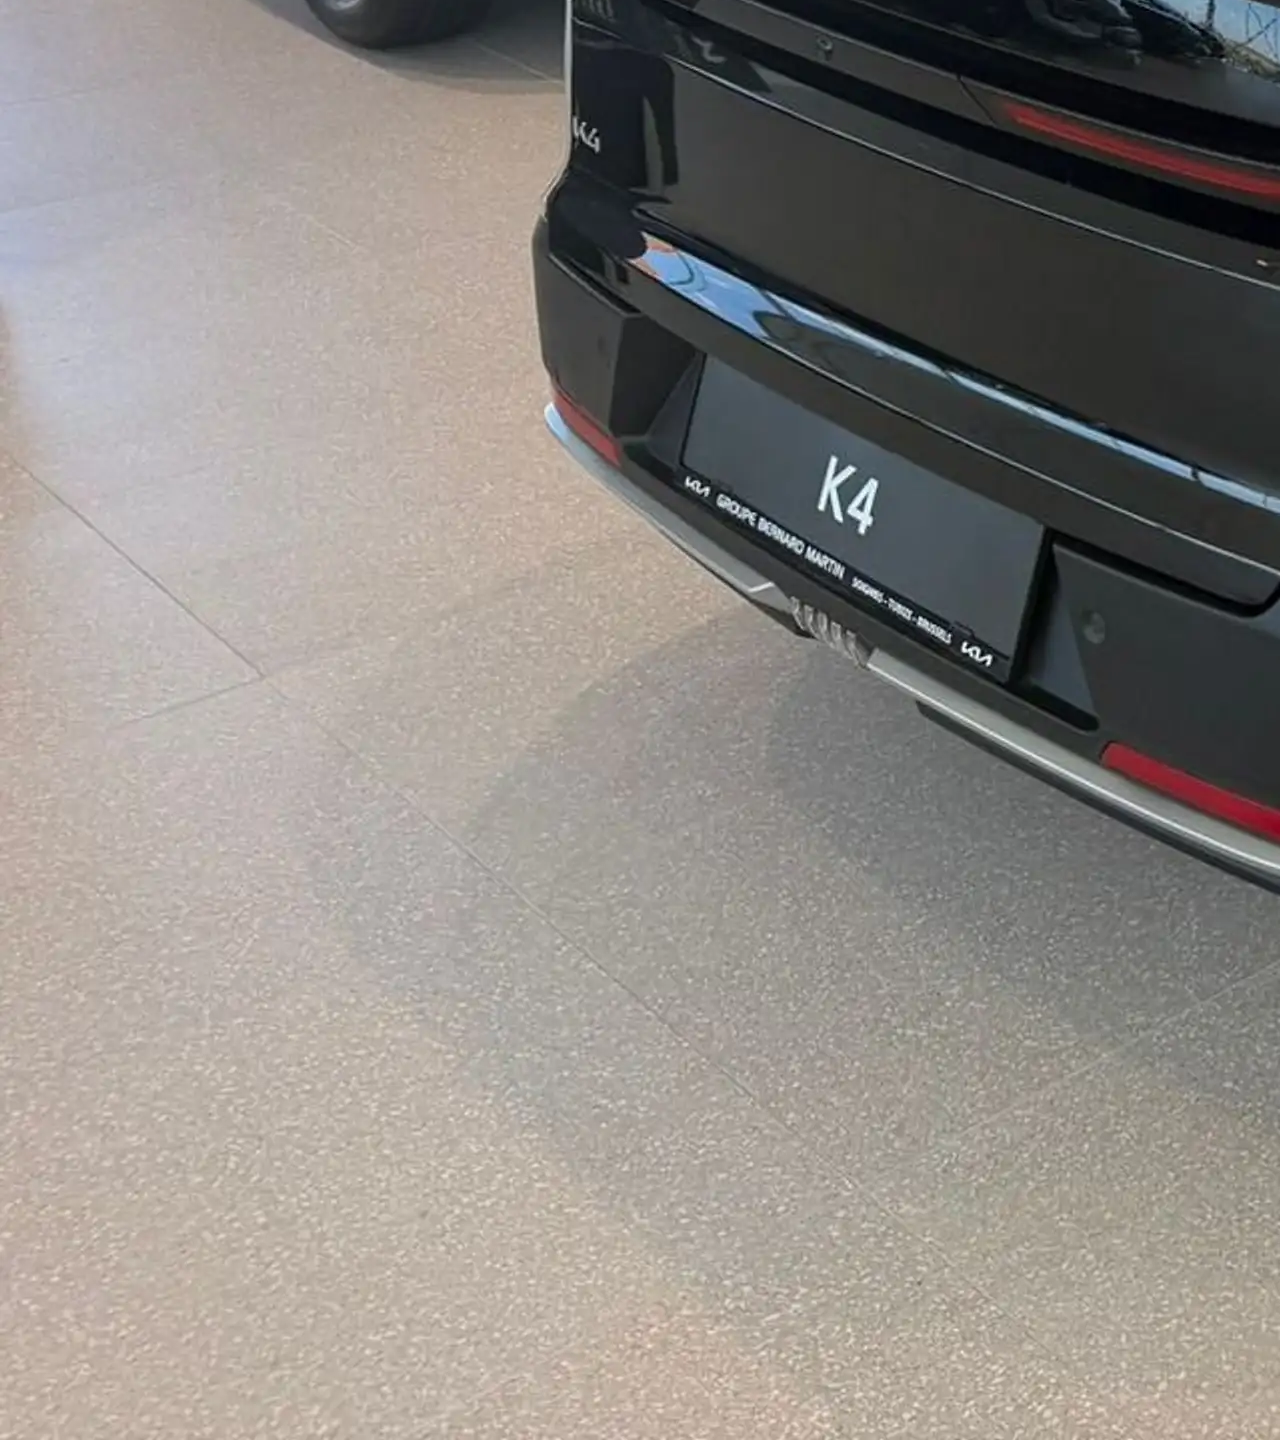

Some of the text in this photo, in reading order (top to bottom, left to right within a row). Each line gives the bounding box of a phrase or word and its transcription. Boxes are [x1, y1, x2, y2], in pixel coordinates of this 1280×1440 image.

[715, 493, 758, 528] GROUPE
[757, 517, 805, 556] BERNARD
[804, 545, 847, 580] MARTIN
[817, 454, 880, 536] K4
